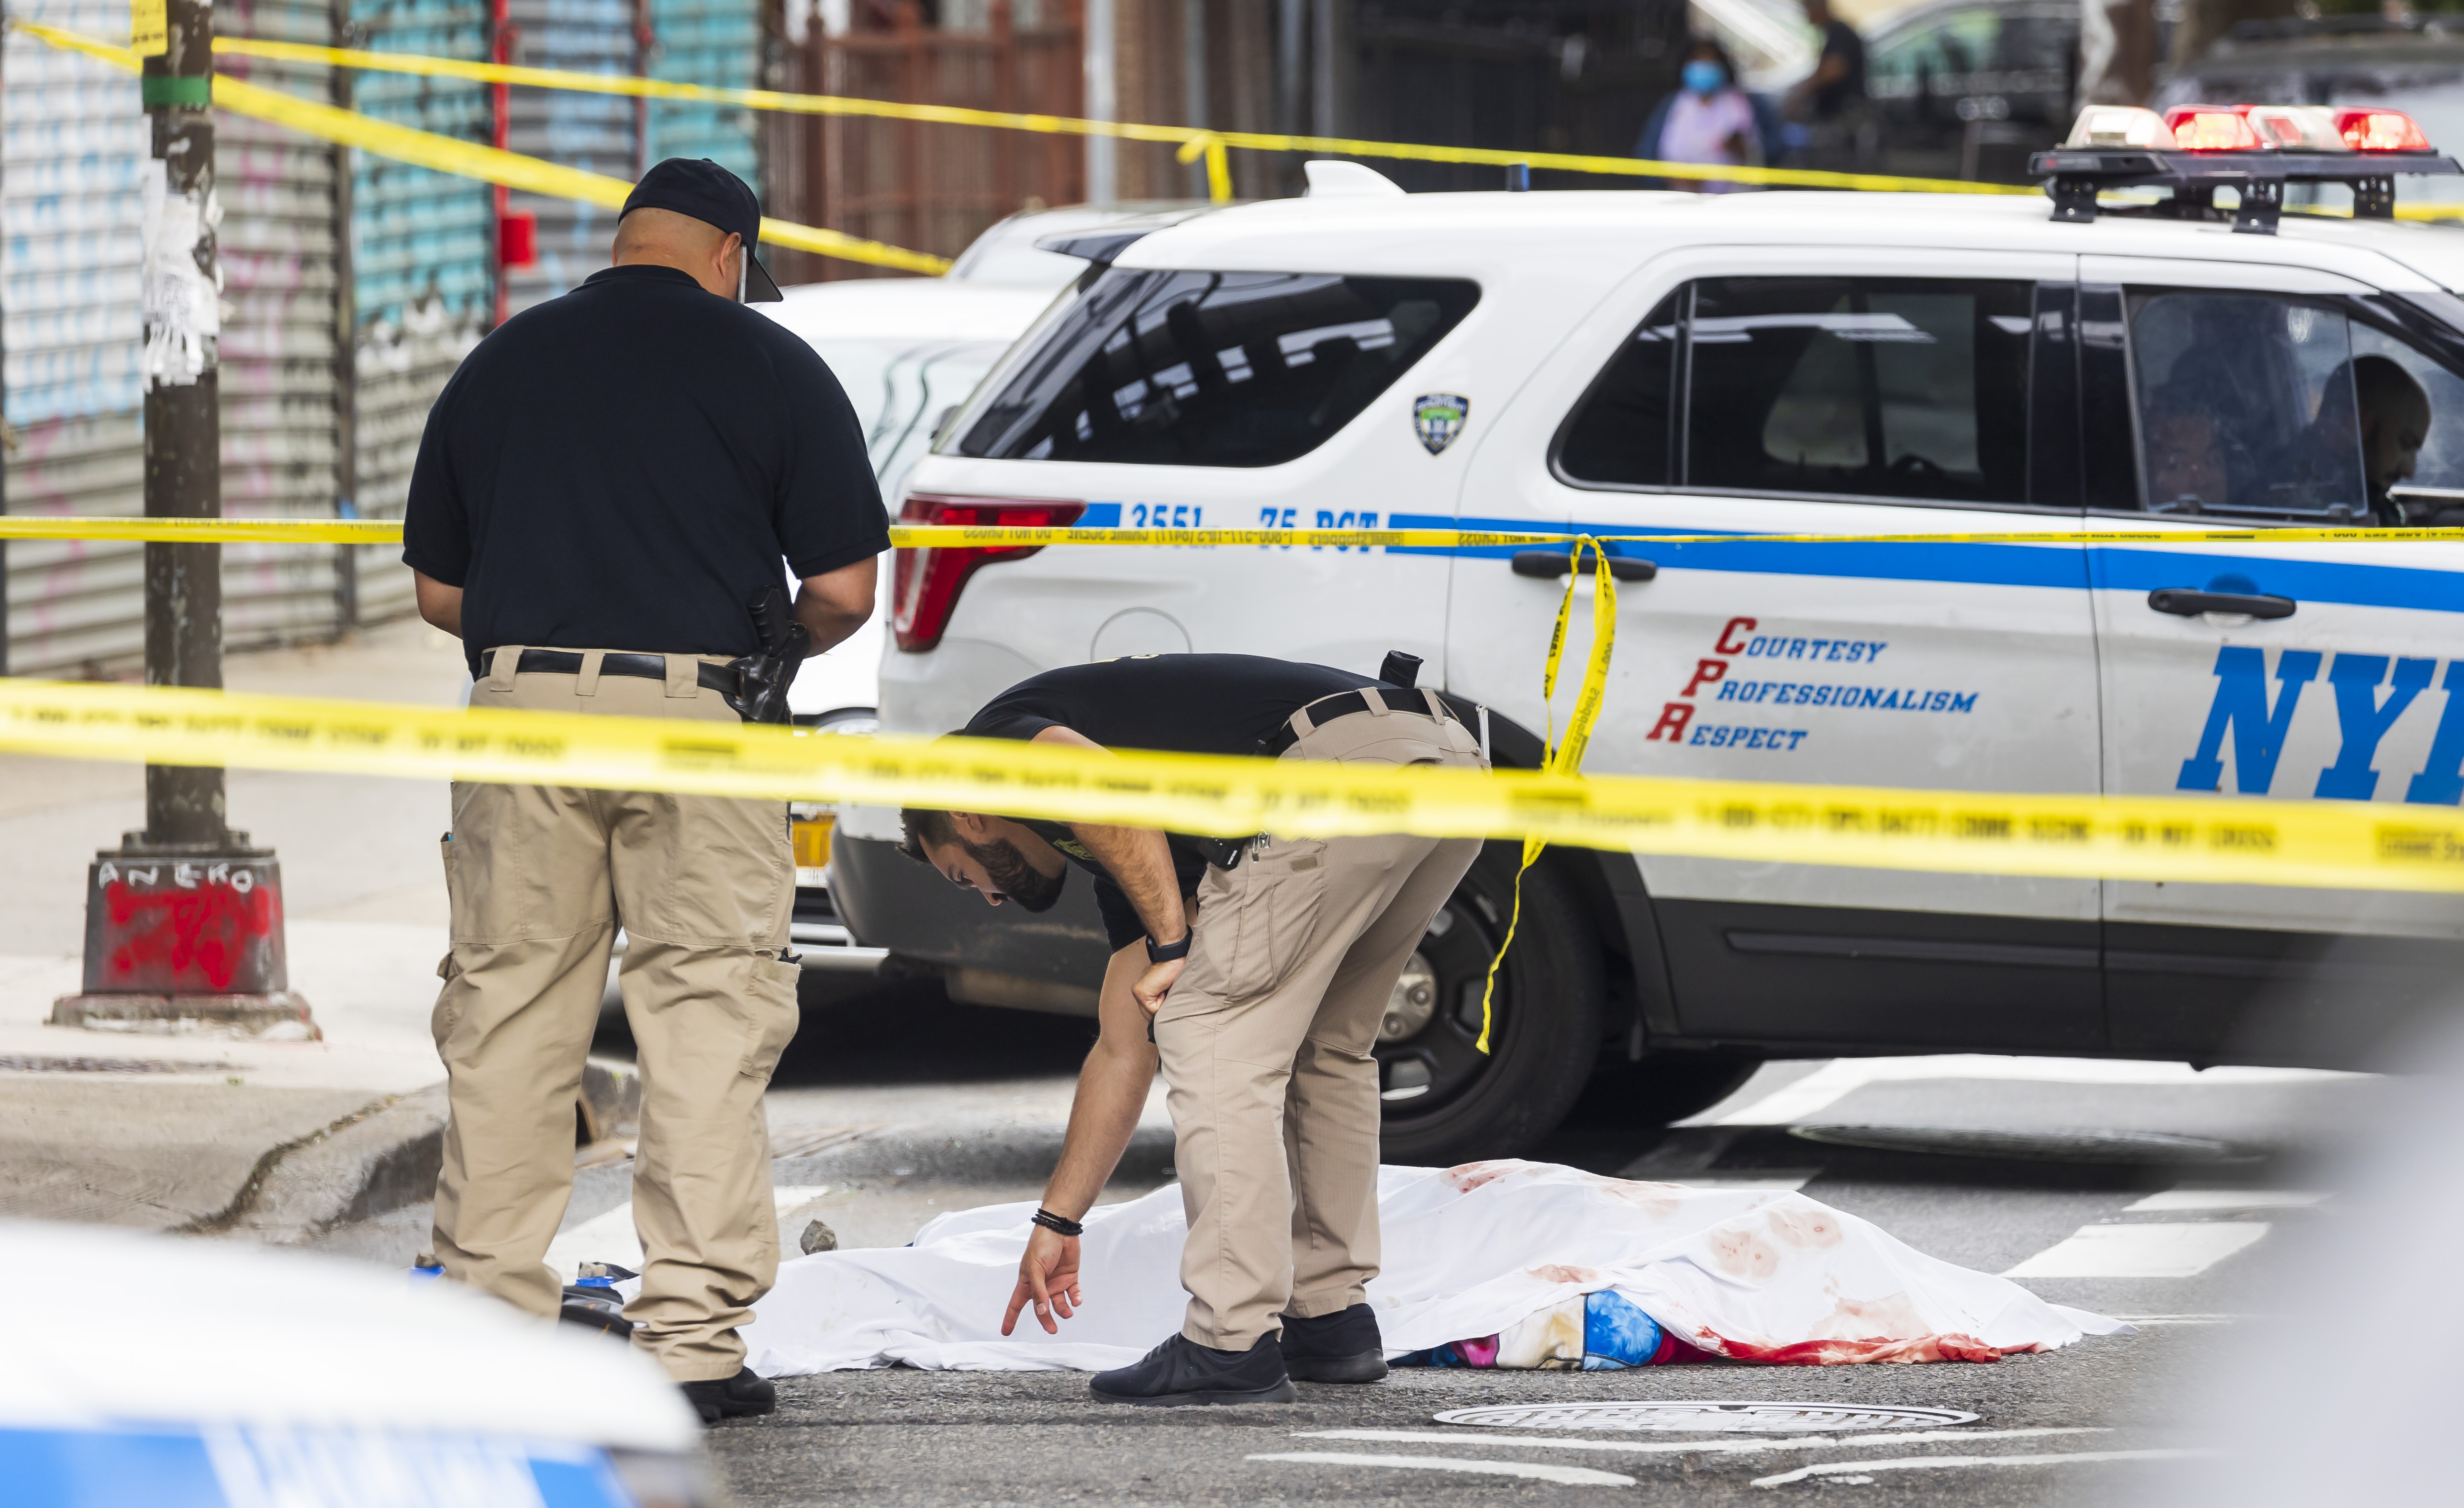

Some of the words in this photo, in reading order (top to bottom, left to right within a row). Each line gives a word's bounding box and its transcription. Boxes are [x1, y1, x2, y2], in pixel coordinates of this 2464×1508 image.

[1714, 616, 1888, 664] COURTESY
[1680, 659, 1980, 713] PROFESSIONALISM
[1646, 702, 1809, 751] RESPECT
